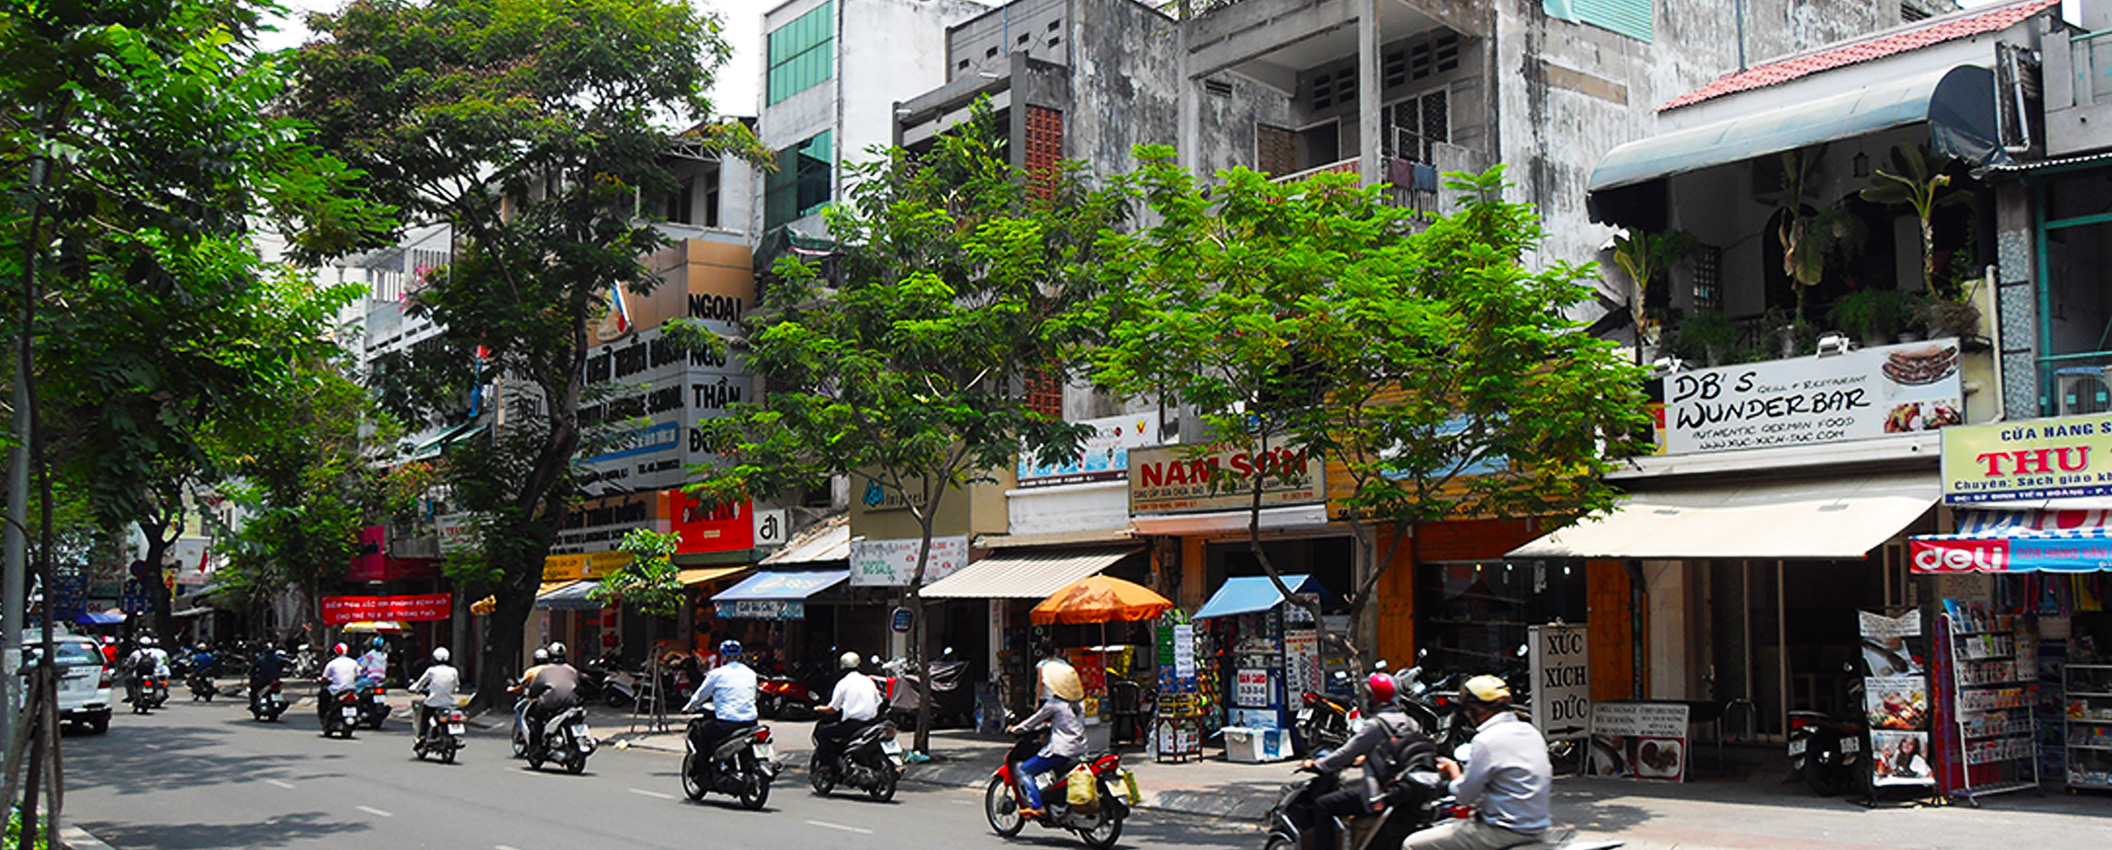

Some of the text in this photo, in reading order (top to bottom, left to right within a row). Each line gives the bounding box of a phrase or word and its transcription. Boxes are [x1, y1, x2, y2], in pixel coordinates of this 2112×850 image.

[688, 293, 742, 328] NGOẠI
[1677, 388, 1871, 430] WUNDERBAR
[1818, 416, 1855, 428] FOOD
[2001, 425, 2037, 441] CỬA
[2044, 422, 2094, 437] HÀNG
[1142, 457, 1220, 487] NAM
[1976, 445, 2092, 477] THU
[1954, 477, 2012, 490] Chuyên:
[1915, 547, 2003, 570] deli
[1547, 630, 1582, 655] XÚC
[1545, 662, 1586, 688] XÍCH
[1552, 694, 1588, 721] ĐỨC
